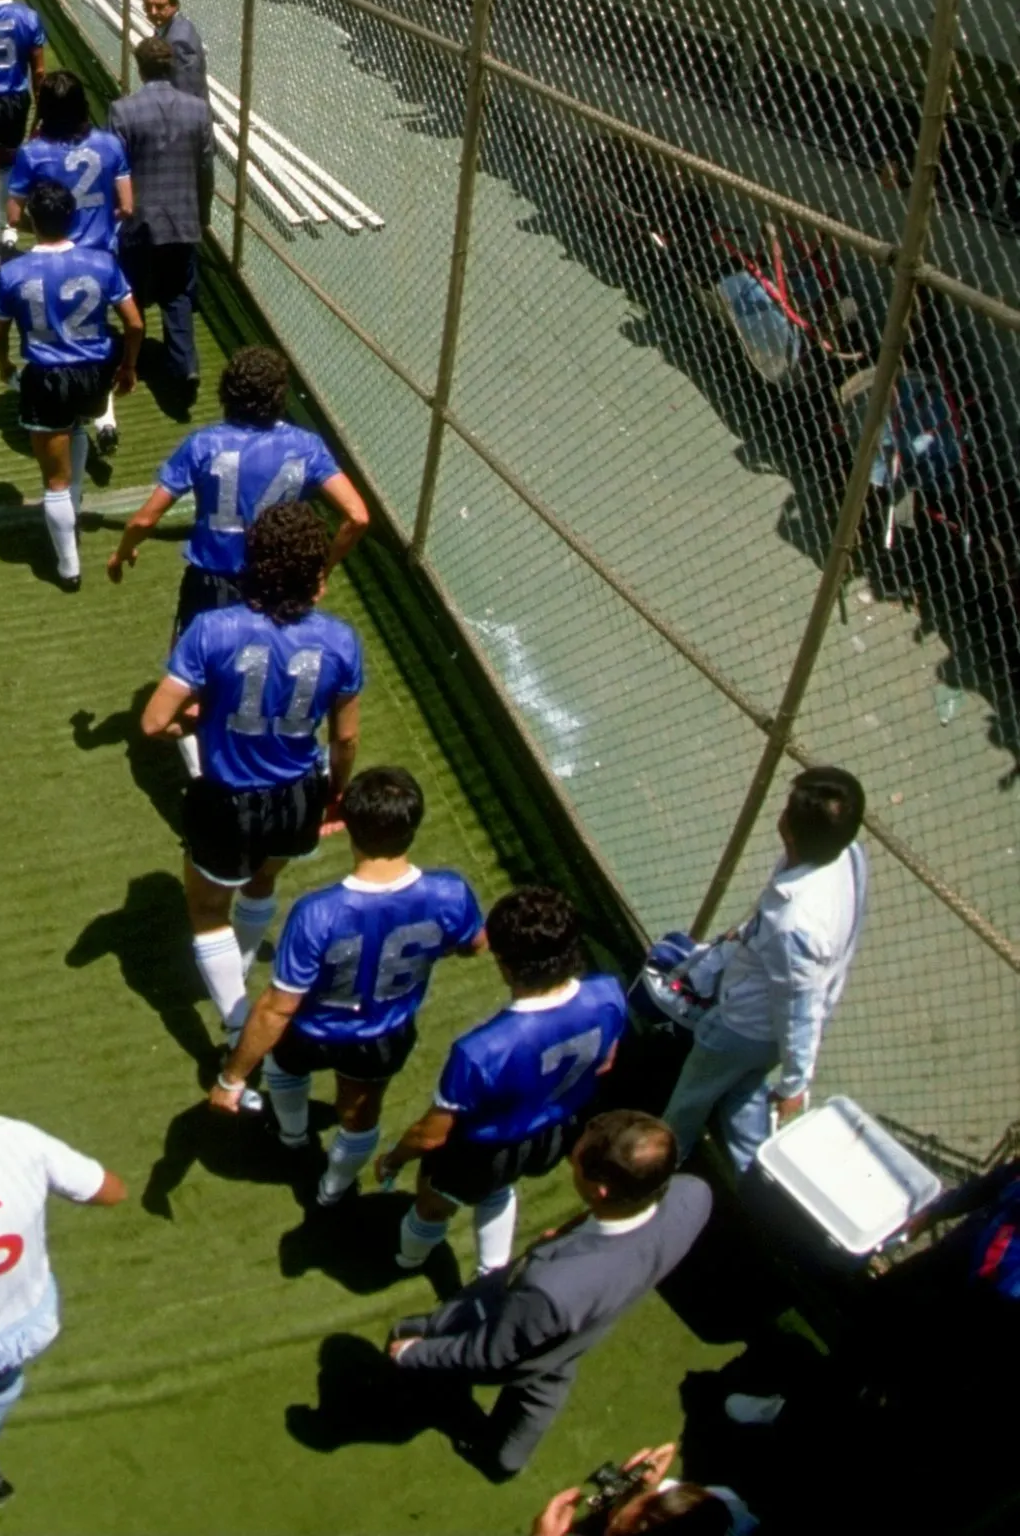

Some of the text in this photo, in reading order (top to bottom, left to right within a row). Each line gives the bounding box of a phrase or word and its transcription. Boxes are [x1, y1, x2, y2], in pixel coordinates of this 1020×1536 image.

[64, 147, 105, 209] 2
[20, 275, 102, 343] 12
[225, 644, 324, 738] 11
[320, 920, 445, 1012] 16
[541, 1026, 602, 1105] 7
